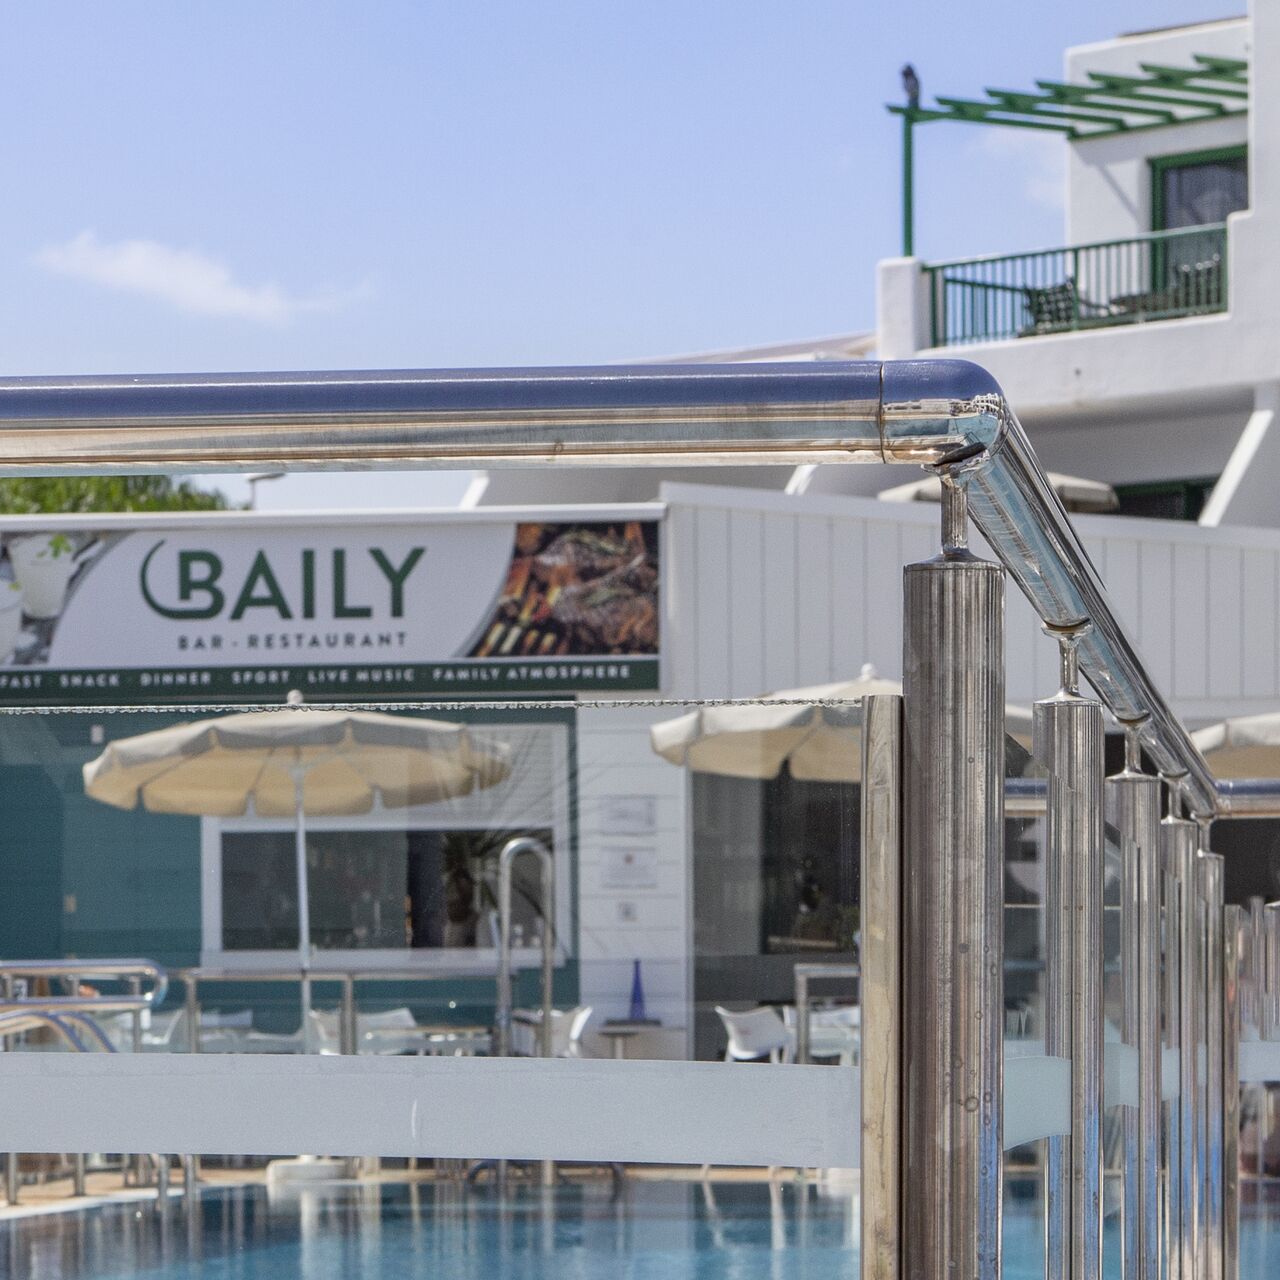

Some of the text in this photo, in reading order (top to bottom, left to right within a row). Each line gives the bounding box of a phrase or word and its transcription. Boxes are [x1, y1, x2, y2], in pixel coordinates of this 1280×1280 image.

[140, 539, 427, 621] BAILY
[177, 635, 224, 651] BAR
[247, 632, 408, 650] RESTAURANT
[58, 673, 121, 688] SNACK
[139, 672, 212, 687] DINNER
[230, 670, 291, 685] SPORT
[307, 669, 350, 683] LIVE
[355, 668, 416, 682] MUSIC
[431, 667, 501, 682] FAMILY
[505, 664, 632, 681] ATMOSPHERE
